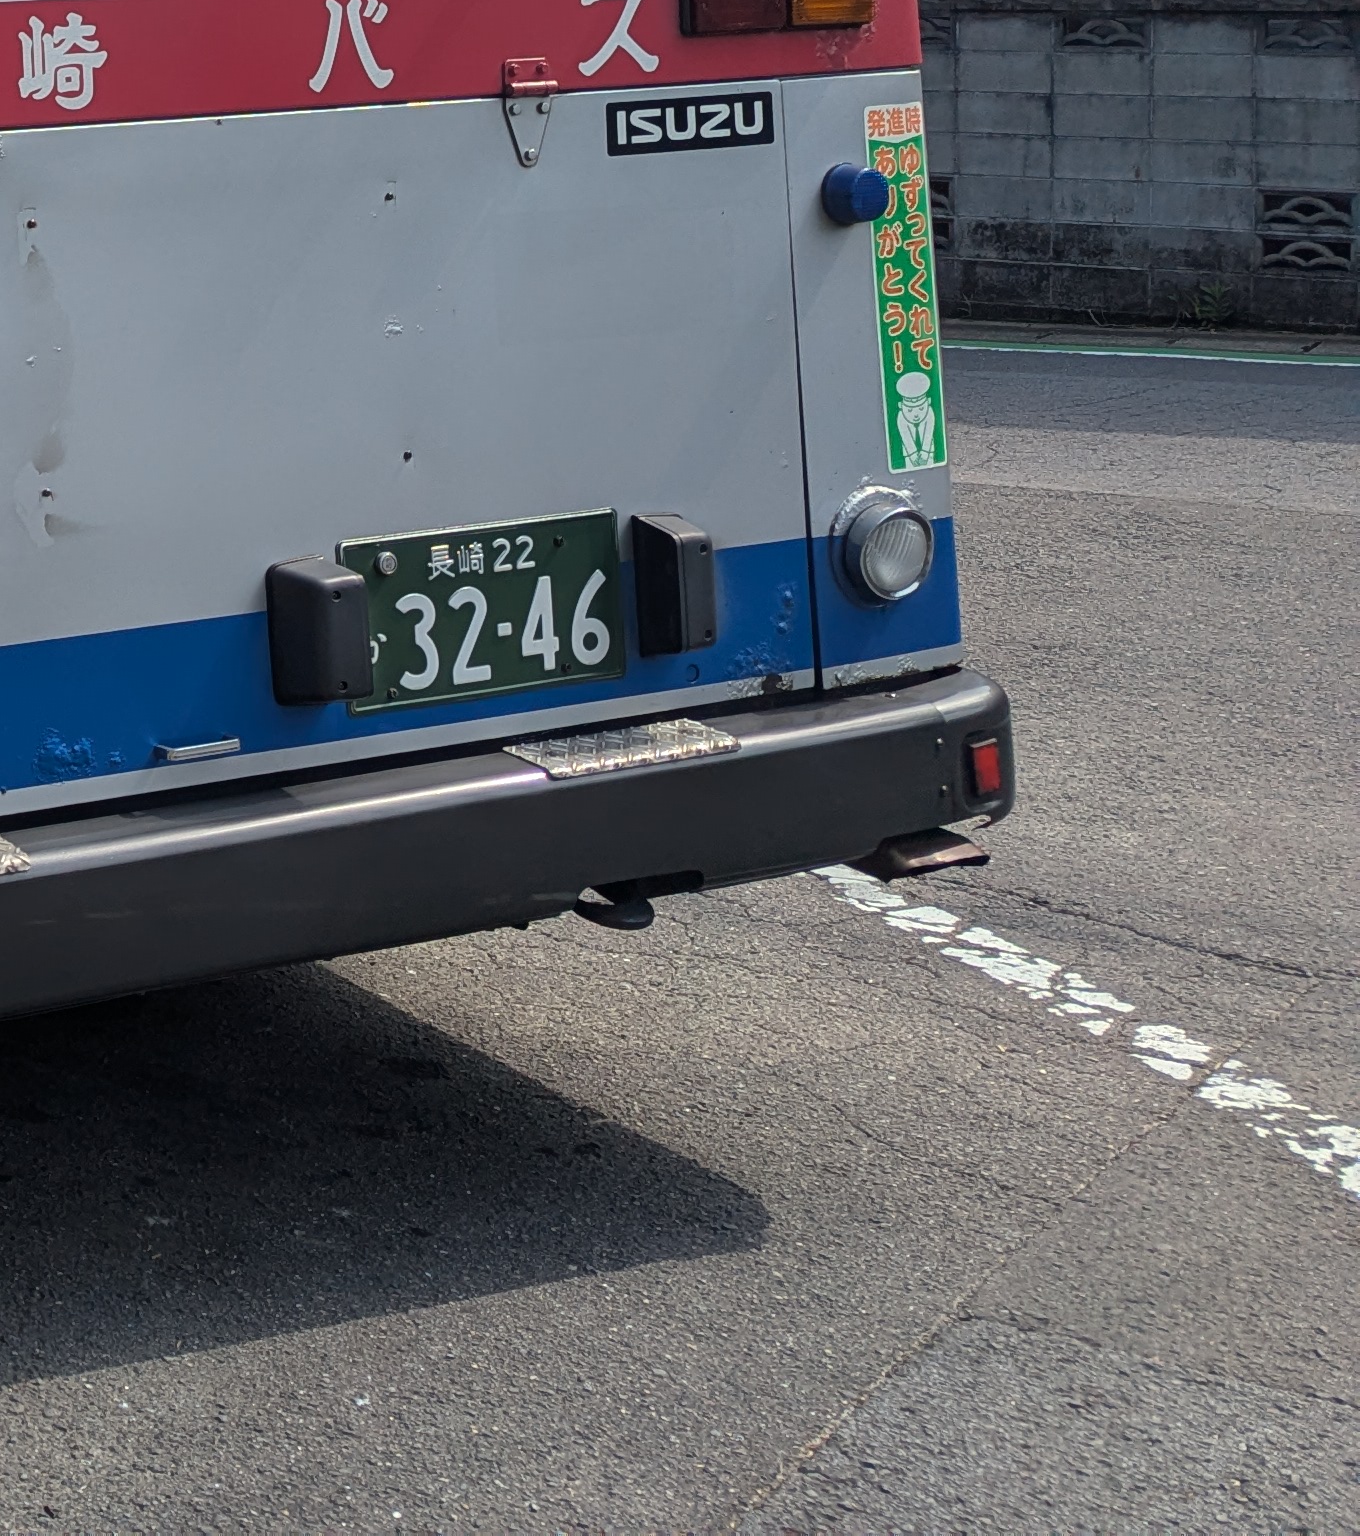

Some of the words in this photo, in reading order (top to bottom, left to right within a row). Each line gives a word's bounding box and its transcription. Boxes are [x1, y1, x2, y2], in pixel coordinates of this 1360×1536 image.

[615, 100, 767, 146] ISUZU
[867, 106, 922, 138] 発進時
[899, 143, 935, 371] ゆずってくれて
[427, 541, 485, 581] 長崎
[491, 534, 536, 573] 22
[394, 568, 607, 692] 32-46
